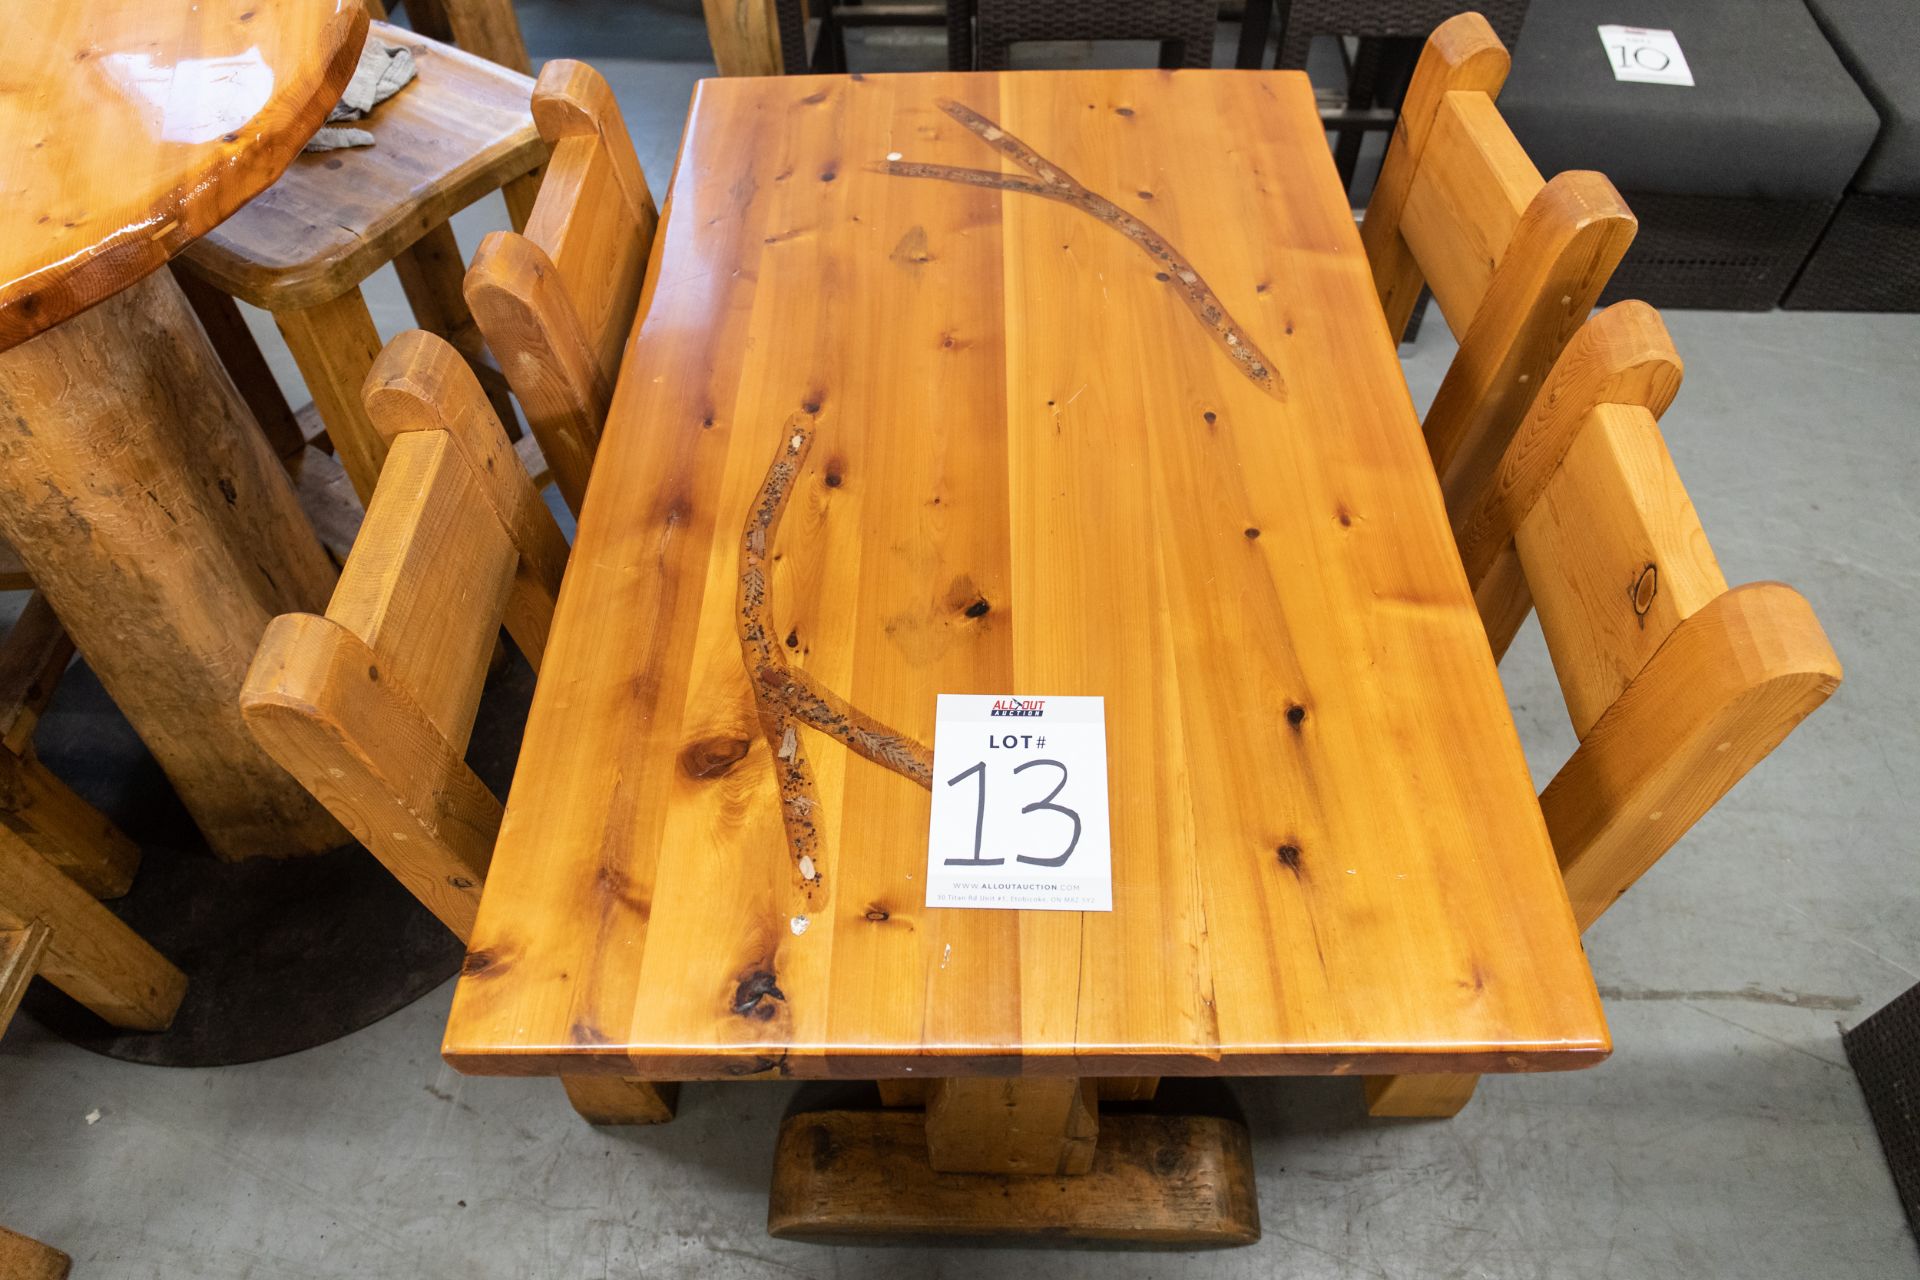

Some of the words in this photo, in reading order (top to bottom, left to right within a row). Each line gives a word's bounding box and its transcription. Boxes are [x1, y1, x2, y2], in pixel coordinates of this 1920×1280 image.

[1611, 44, 1670, 71] 10
[993, 700, 1016, 710] ALL
[1021, 700, 1045, 710] OUT
[944, 758, 1082, 868] 13
